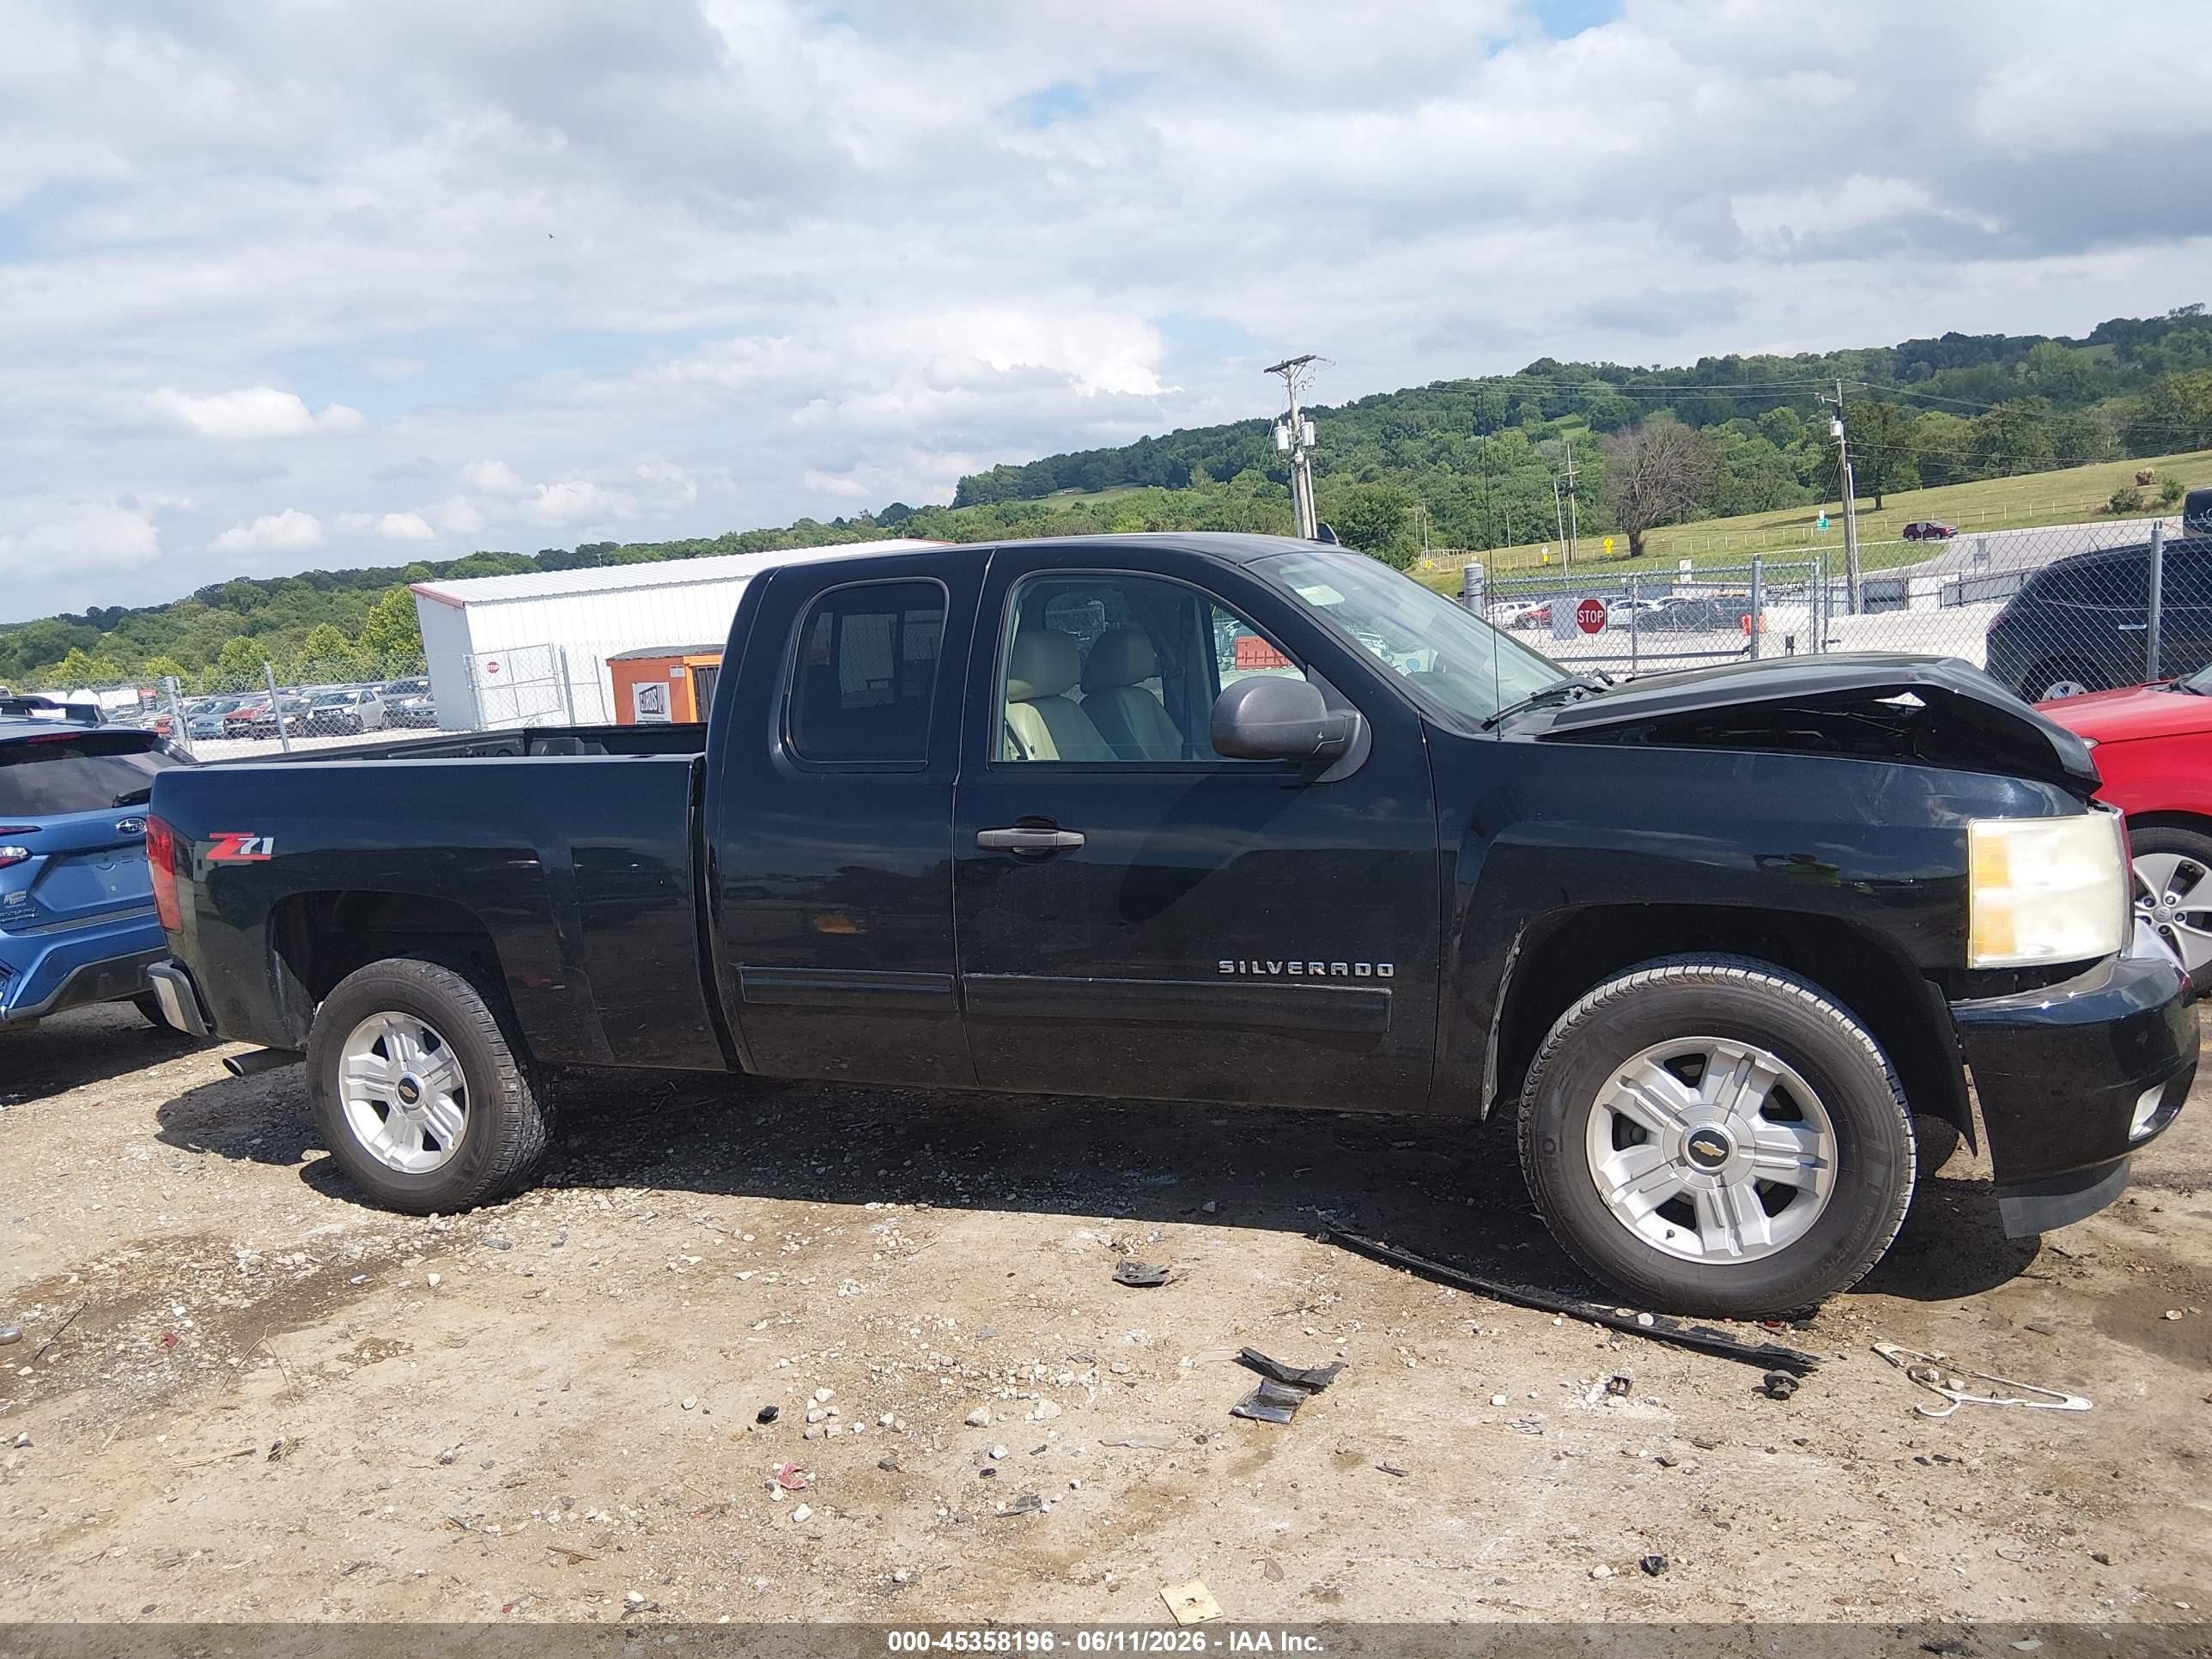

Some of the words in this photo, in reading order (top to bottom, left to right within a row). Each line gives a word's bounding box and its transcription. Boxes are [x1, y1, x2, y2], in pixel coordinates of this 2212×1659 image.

[1767, 582, 1803, 591] modern
[1578, 610, 1604, 623] STOP
[206, 832, 275, 861] Z71
[1218, 960, 1395, 978] SILVERADO
